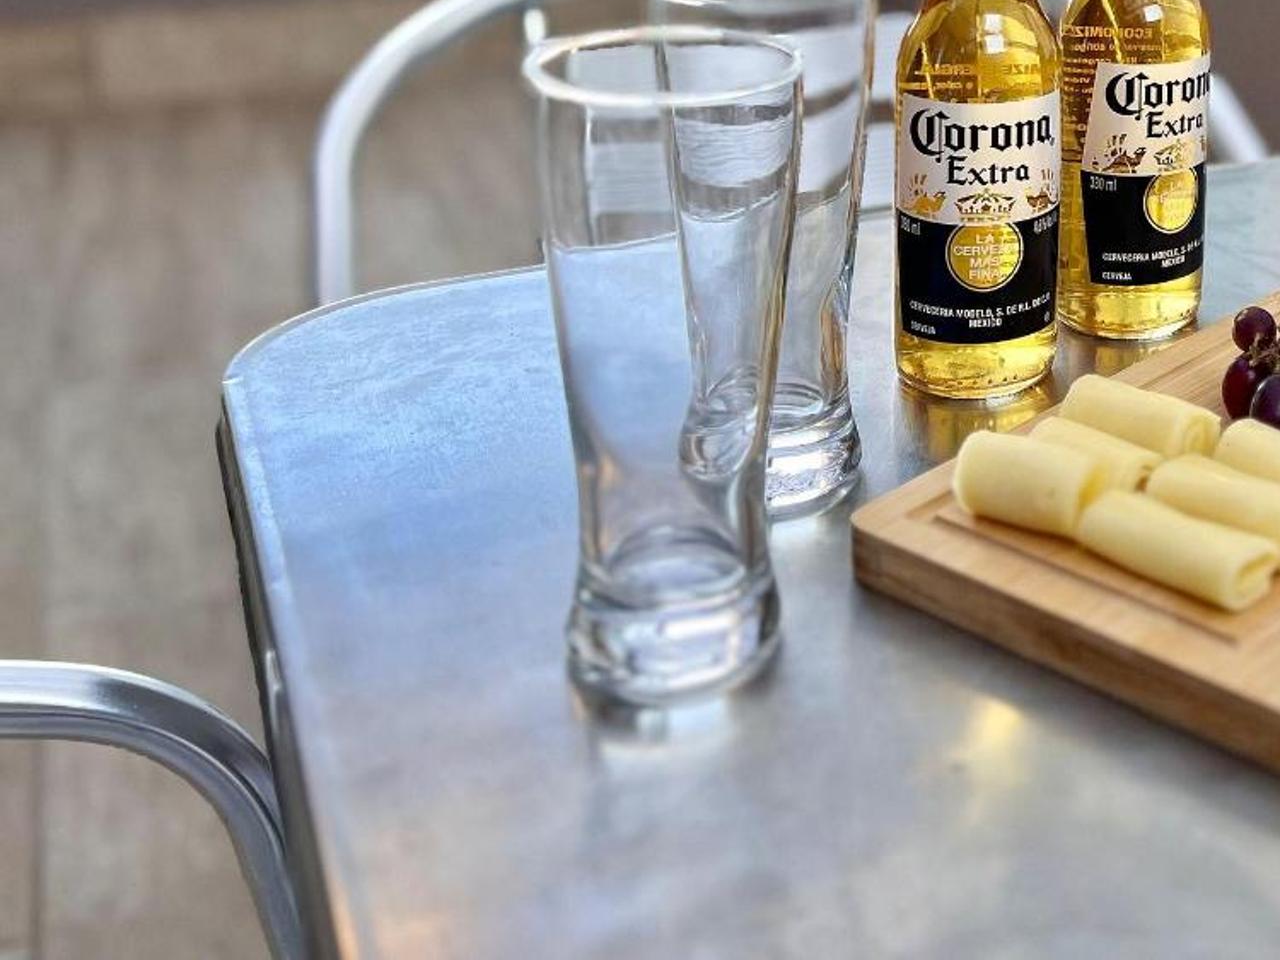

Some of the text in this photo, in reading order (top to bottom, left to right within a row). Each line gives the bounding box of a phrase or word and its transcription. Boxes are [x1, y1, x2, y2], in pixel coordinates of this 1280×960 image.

[910, 108, 1054, 163] Corona
[1145, 110, 1203, 138] Extra
[946, 155, 1030, 186] Extra
[975, 233, 995, 244] LA
[968, 268, 1001, 281] FINA
